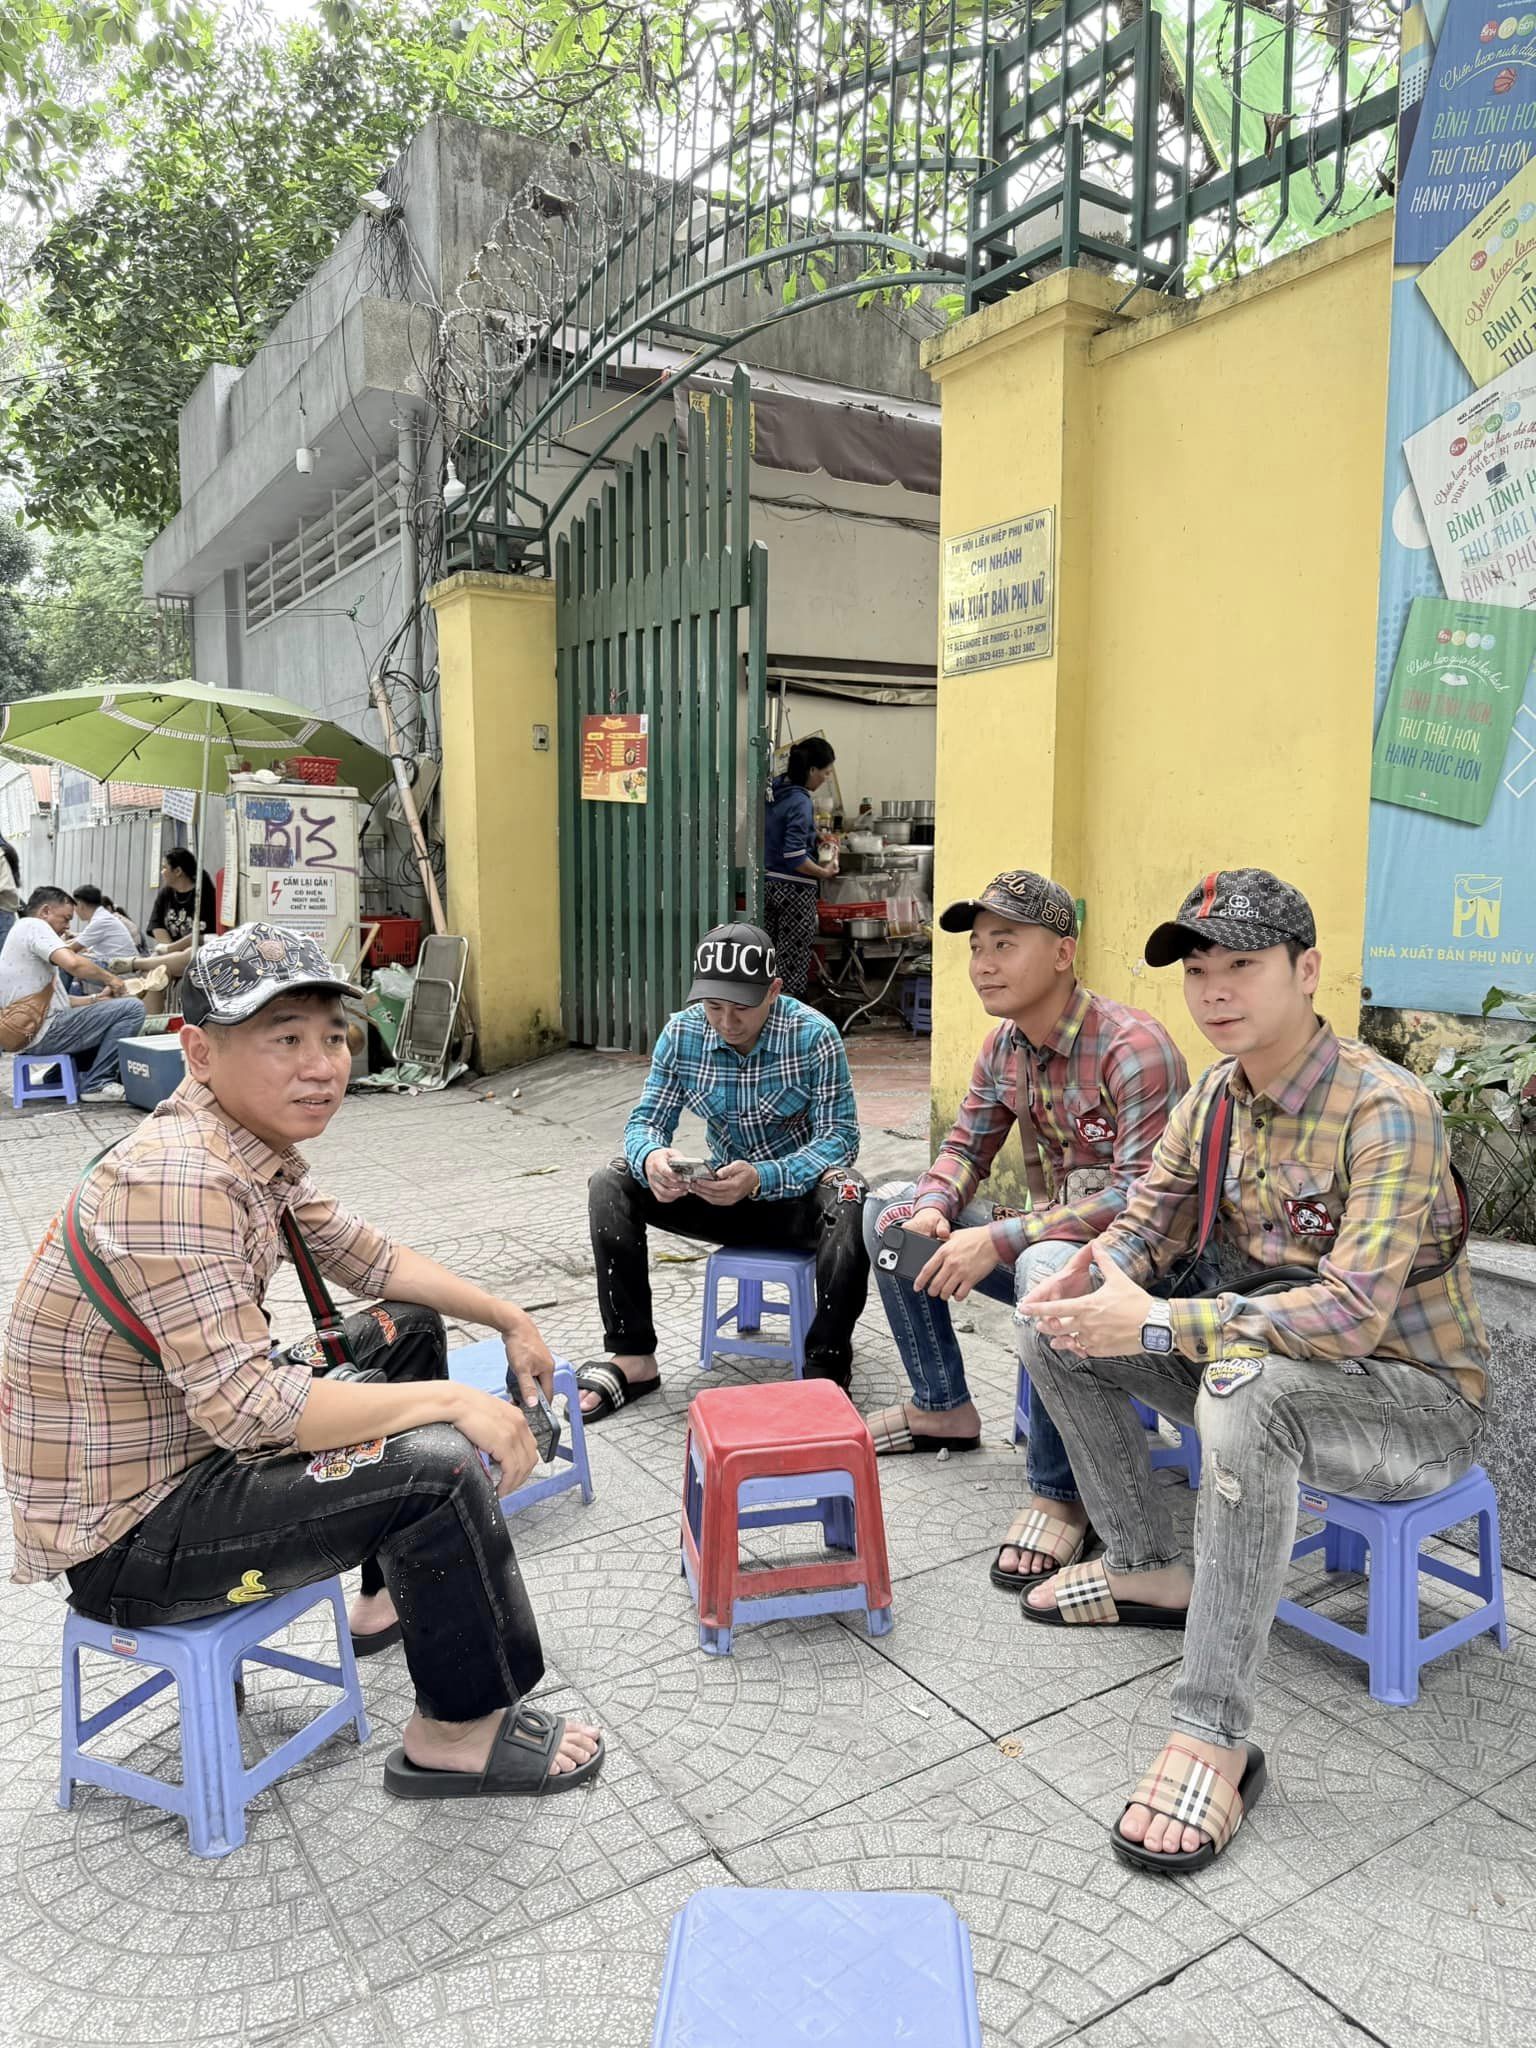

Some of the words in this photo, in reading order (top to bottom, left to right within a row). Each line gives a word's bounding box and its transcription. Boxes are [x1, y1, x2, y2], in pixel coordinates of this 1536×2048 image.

[1432, 106, 1471, 139] BÌNH
[1474, 101, 1511, 135] TĨNH
[1512, 101, 1536, 131] HƠ
[1428, 145, 1461, 176] THƯ
[1460, 139, 1496, 173] THÁI
[1496, 139, 1532, 171] HƠN
[1410, 184, 1452, 219] HẠNH
[1453, 175, 1497, 211] PHÚC
[1482, 306, 1522, 351] BÌNH
[1500, 330, 1534, 367] THƯ
[1035, 518, 1045, 529] VN
[1446, 503, 1485, 543] BÌNH
[1486, 478, 1525, 517] TĨNH
[1459, 531, 1491, 568] THƯ
[1491, 511, 1530, 549] THÁI
[1506, 535, 1536, 577] PHÚ
[970, 557, 987, 576] CHI
[989, 546, 1022, 571] NHÁNH
[949, 591, 966, 626] NHÀ
[968, 583, 989, 622] XUẤT
[991, 579, 1009, 616] BẢN
[1011, 580, 1029, 614] PHỤ
[1032, 571, 1046, 606] NỮ
[982, 635, 989, 645] DE
[1399, 717, 1424, 740] THƯ
[1424, 721, 1452, 747] THÁI
[1384, 743, 1418, 768] HẠNH
[1420, 749, 1453, 775] PHÚC
[1454, 757, 1482, 782] HƠN
[1041, 901, 1071, 932] 56
[697, 941, 777, 979] GUCC
[1370, 943, 1396, 958] NHÀ
[1400, 943, 1434, 960] XUẤT
[1437, 946, 1465, 961] BẢN
[1469, 950, 1497, 967] PHỤ
[1501, 949, 1521, 965] NỮ
[127, 1059, 151, 1079] PEPSI
